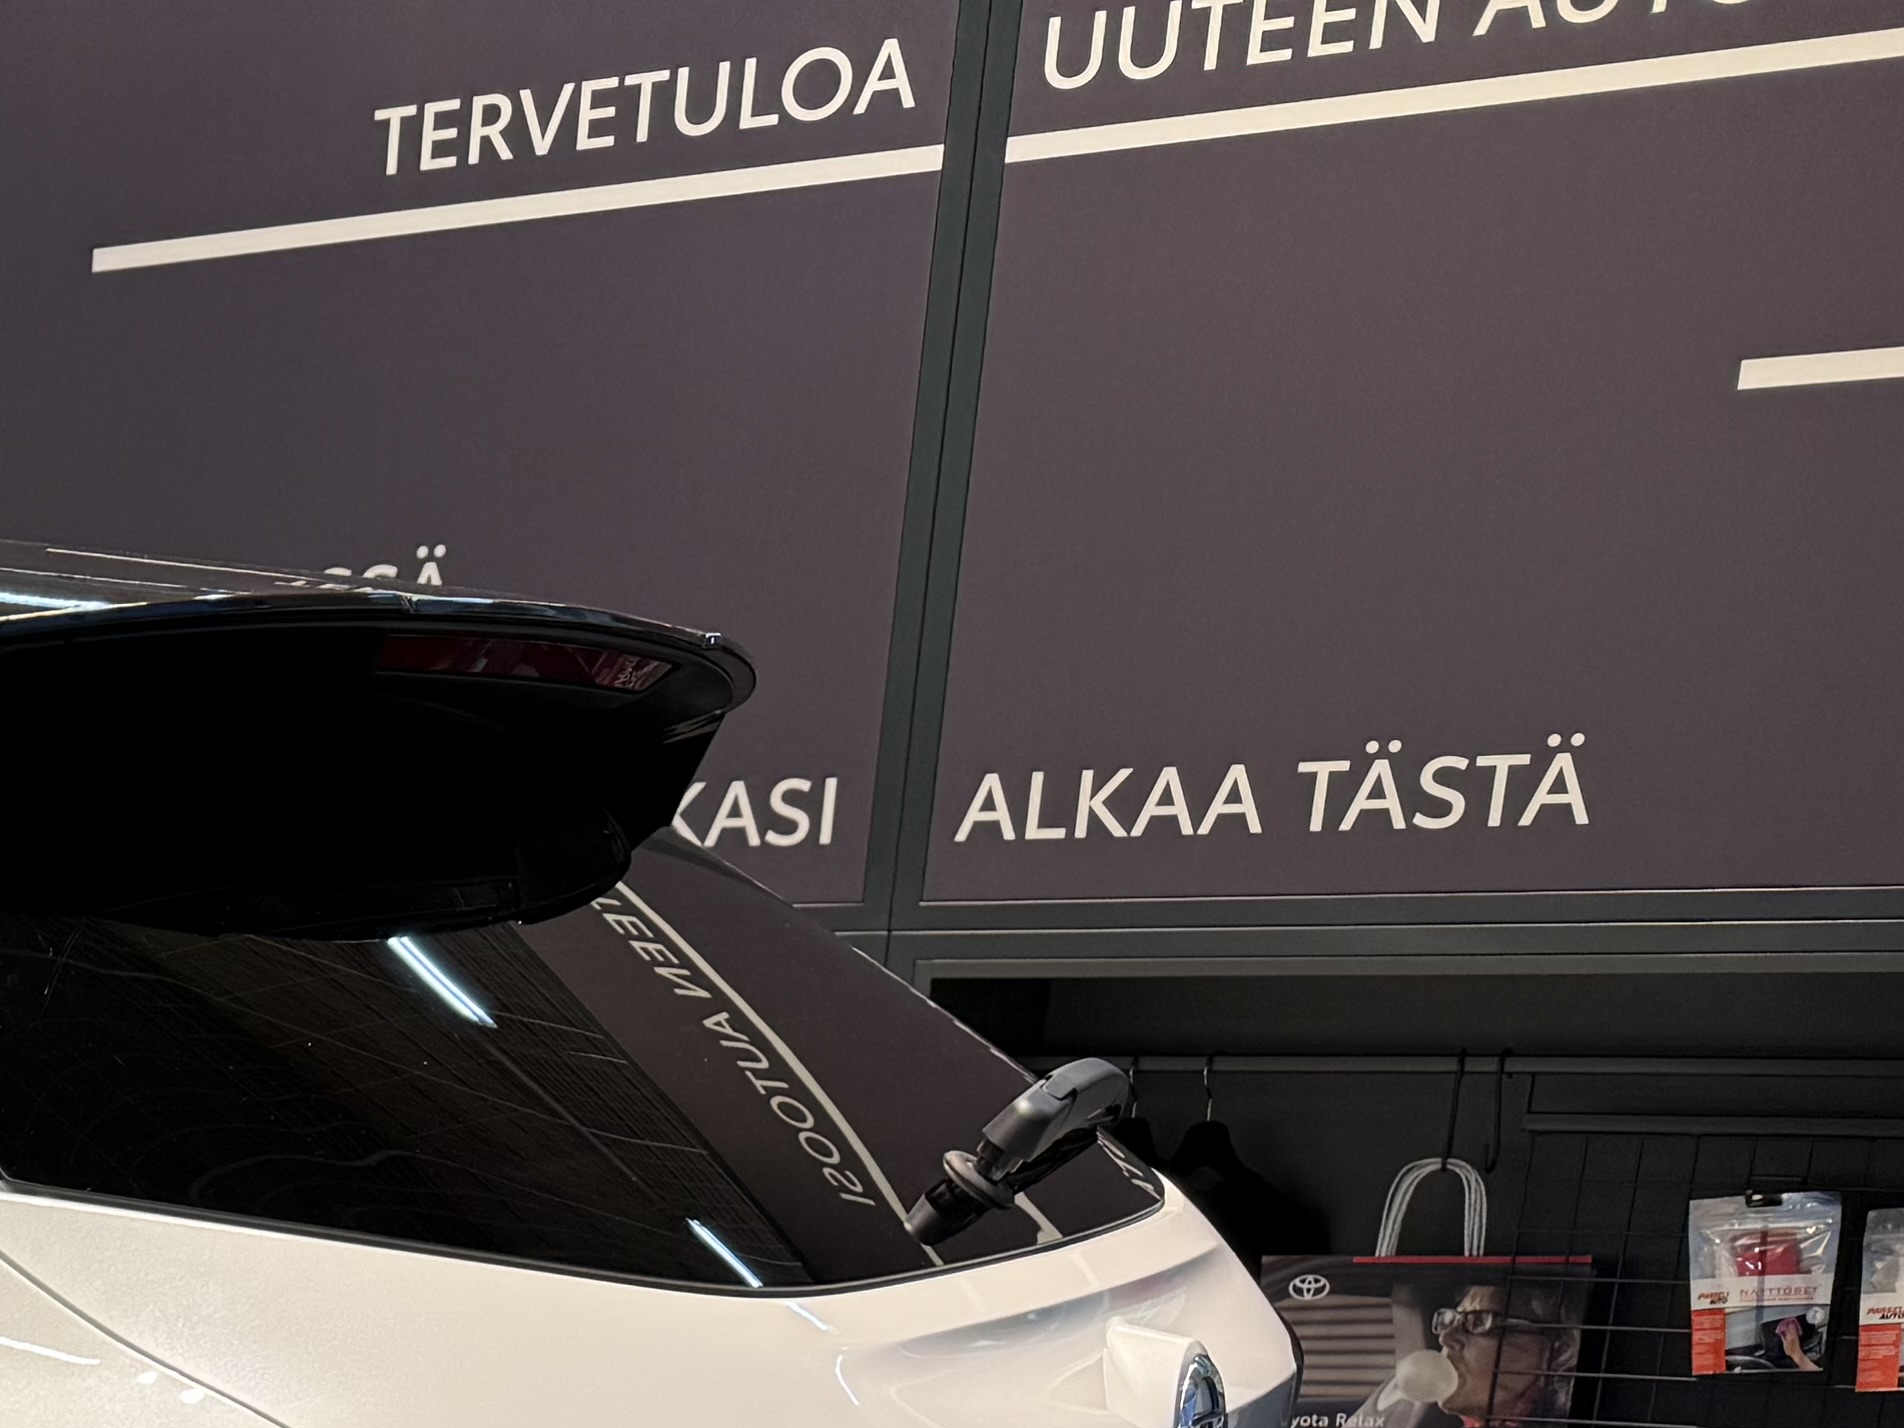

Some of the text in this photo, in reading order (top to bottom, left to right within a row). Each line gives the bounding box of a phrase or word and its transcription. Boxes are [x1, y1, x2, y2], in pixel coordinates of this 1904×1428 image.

[373, 37, 917, 177] TERVETULOA
[672, 732, 1591, 848] KASI ALKAA TÄSTÄ
[1335, 1413, 1386, 1428] Relax
